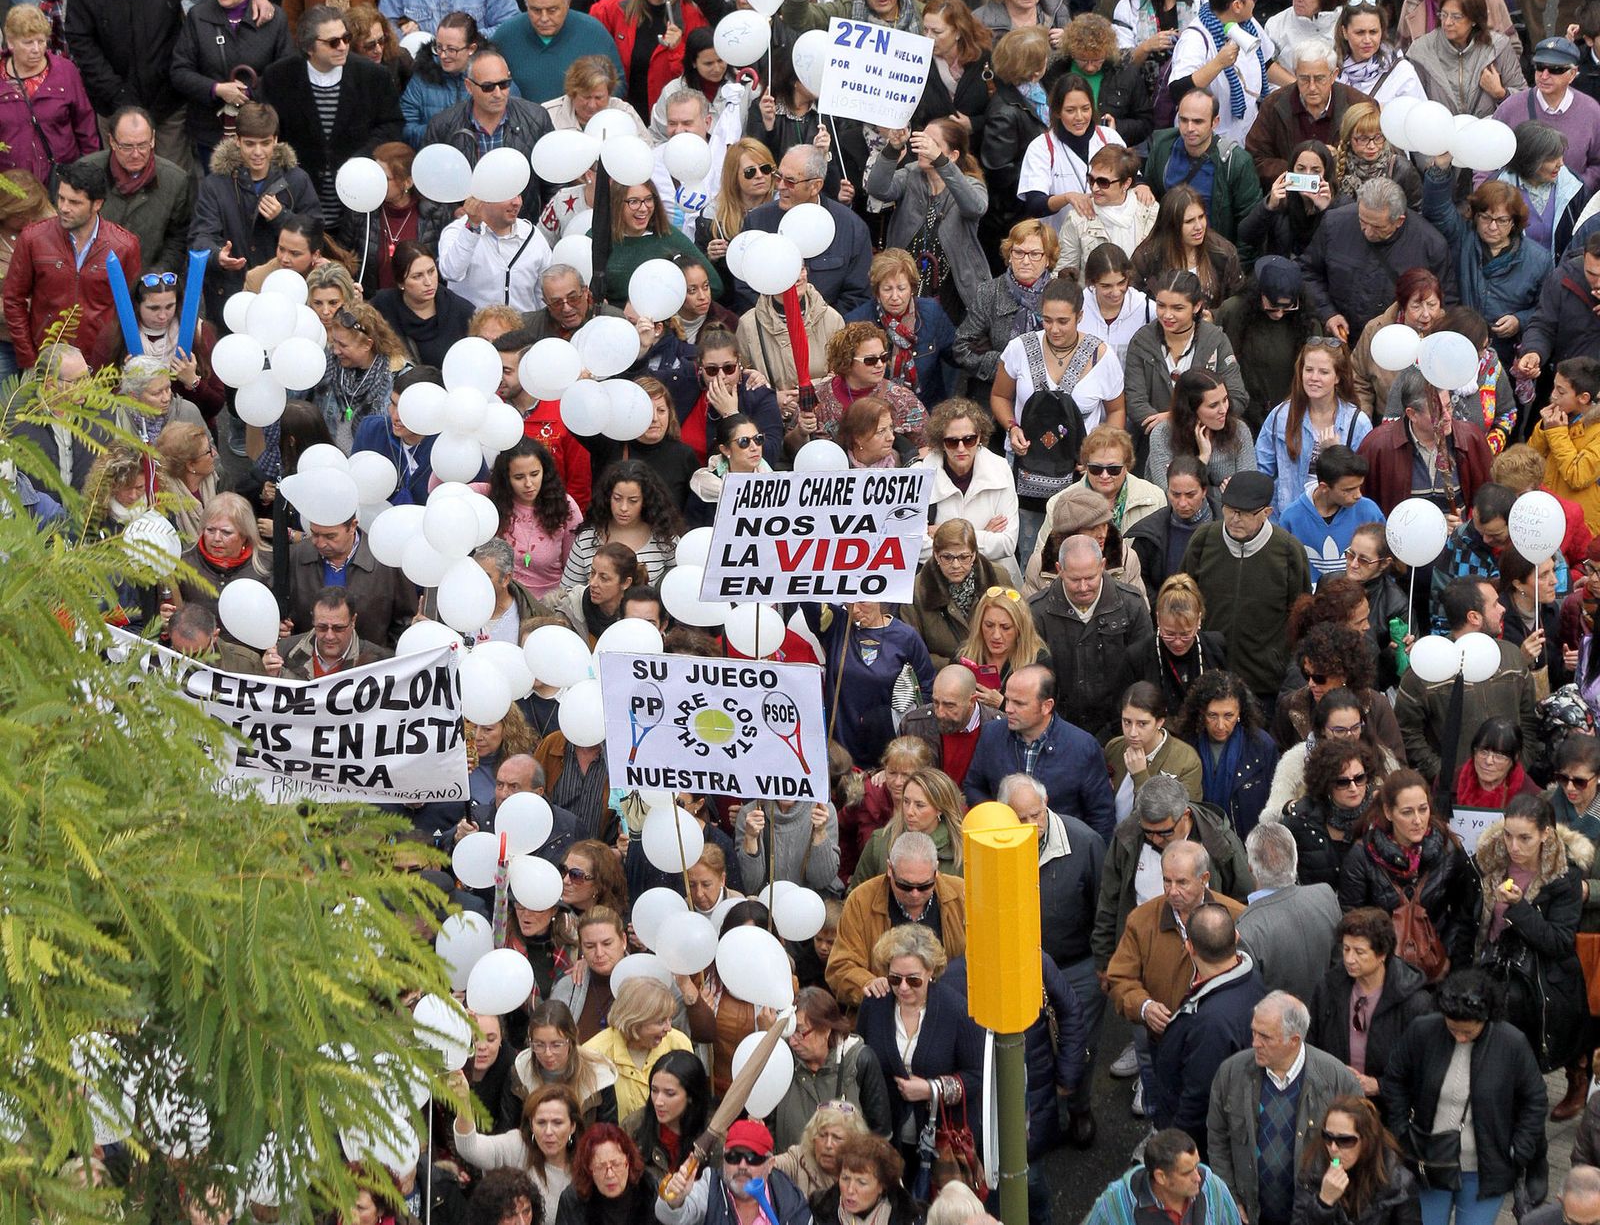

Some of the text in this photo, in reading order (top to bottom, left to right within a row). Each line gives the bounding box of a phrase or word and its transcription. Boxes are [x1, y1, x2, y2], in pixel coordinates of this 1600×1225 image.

[834, 21, 891, 55] 27-N
[830, 58, 924, 85] POR UNA SANIDAD
[895, 49, 924, 65] HUELVA
[732, 475, 923, 516] ¡ABRID CHARE COSTA!
[734, 514, 877, 537] NOS VA
[720, 537, 906, 572] LA VIDA
[719, 574, 888, 596] EN ELLO
[632, 659, 778, 689] SU JUEGO
[271, 684, 319, 716] DE
[631, 696, 663, 716] PP
[763, 703, 796, 724] PSOE
[311, 722, 364, 760] EN
[235, 746, 394, 789] ESPERA
[626, 766, 815, 798] NUESTRA VIDA
